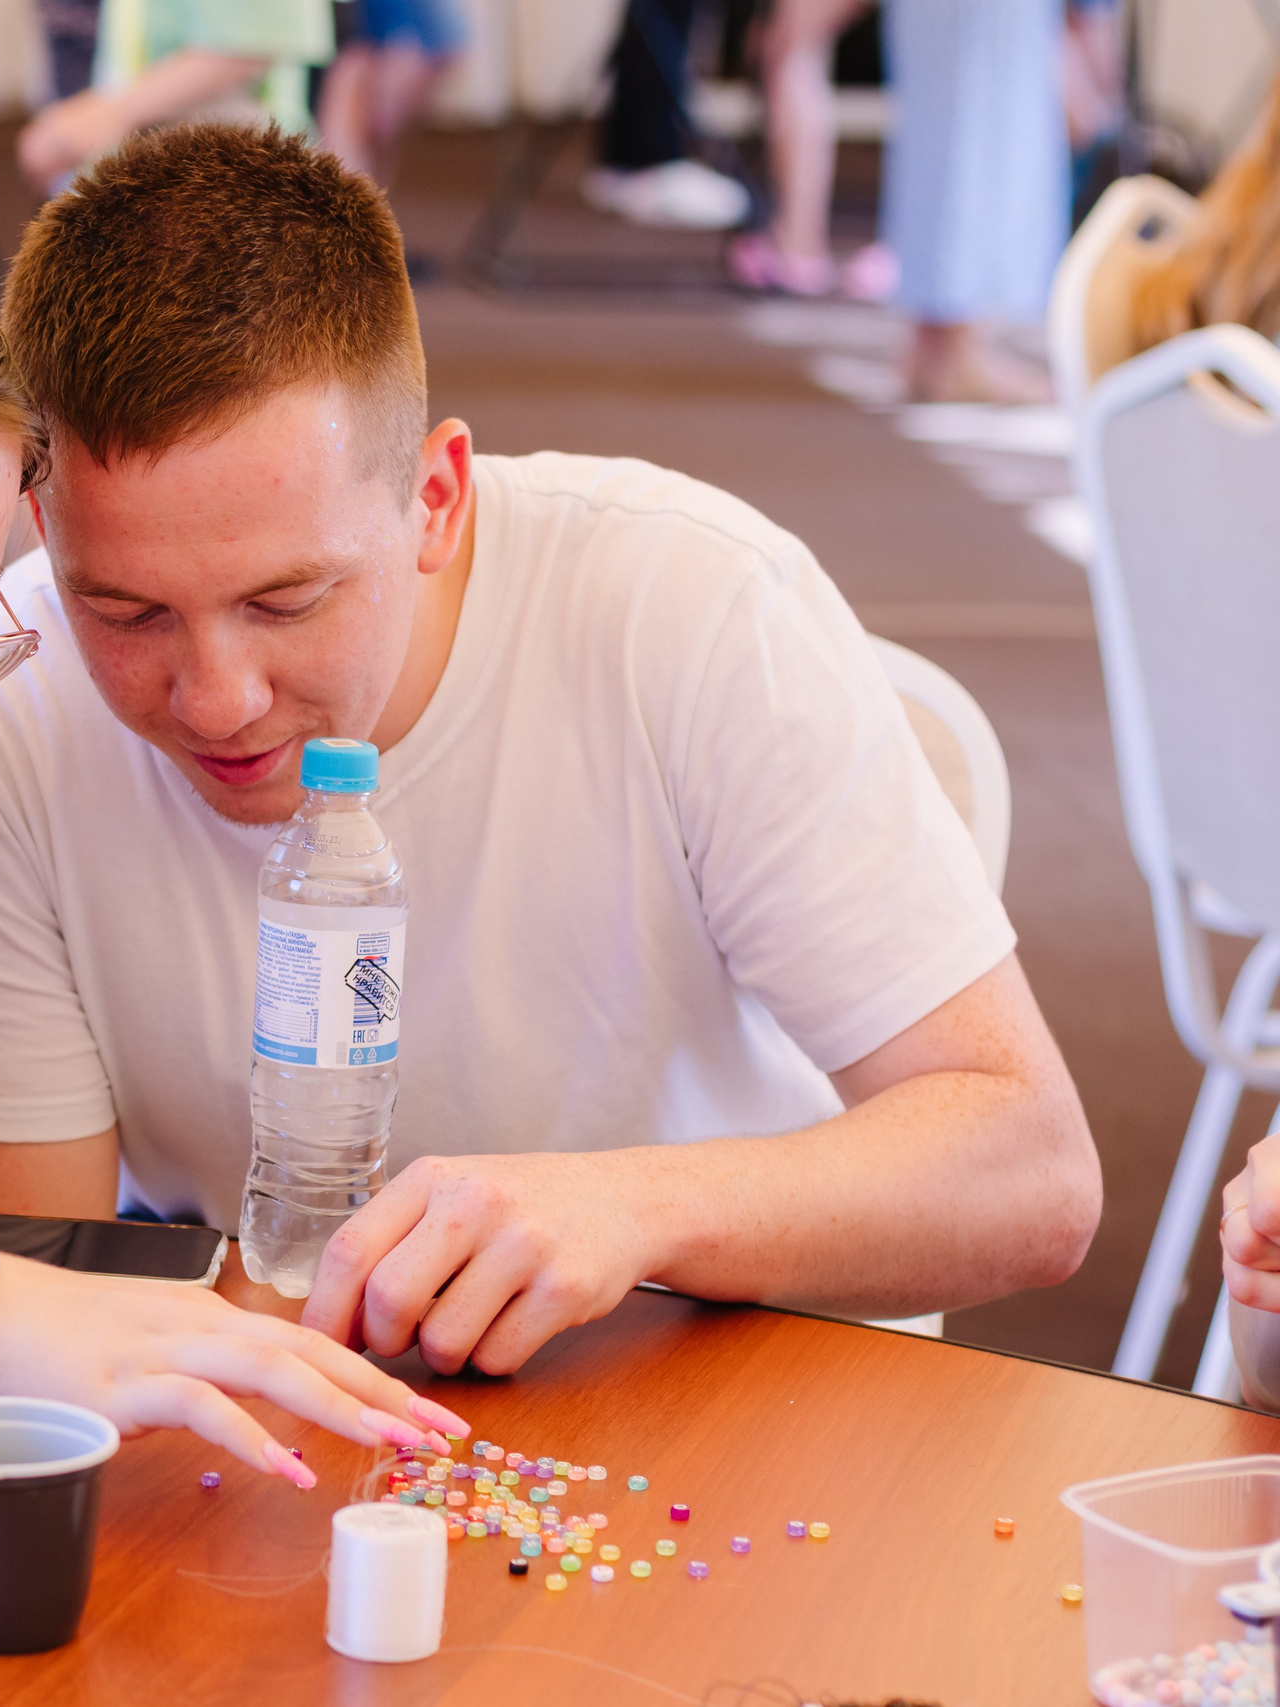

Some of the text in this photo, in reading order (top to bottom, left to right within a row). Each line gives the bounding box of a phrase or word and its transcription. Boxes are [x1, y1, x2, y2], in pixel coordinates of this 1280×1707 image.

[352, 973, 395, 1014] НРАВИТСЯ
[360, 965, 399, 1004] МНЕ ТОЖЕ
